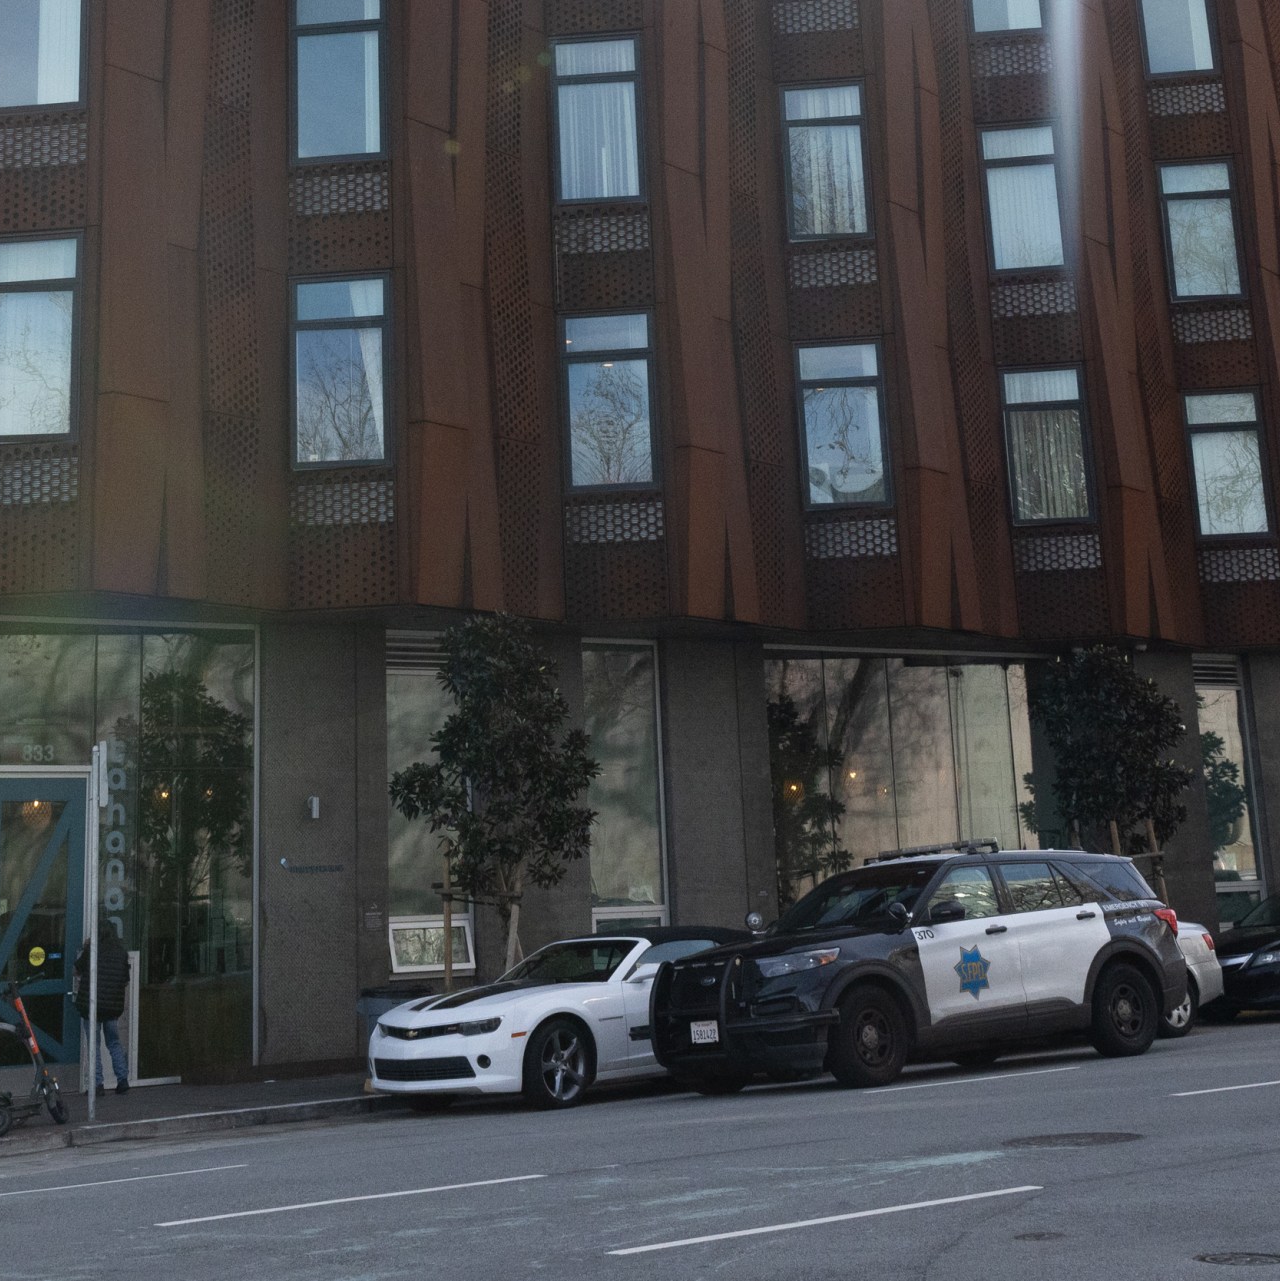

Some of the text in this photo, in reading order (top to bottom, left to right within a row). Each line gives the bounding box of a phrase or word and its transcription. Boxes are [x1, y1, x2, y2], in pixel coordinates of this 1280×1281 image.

[23, 745, 54, 761] 833
[1102, 901, 1138, 912] EMERGENCY
[915, 929, 934, 940] 370
